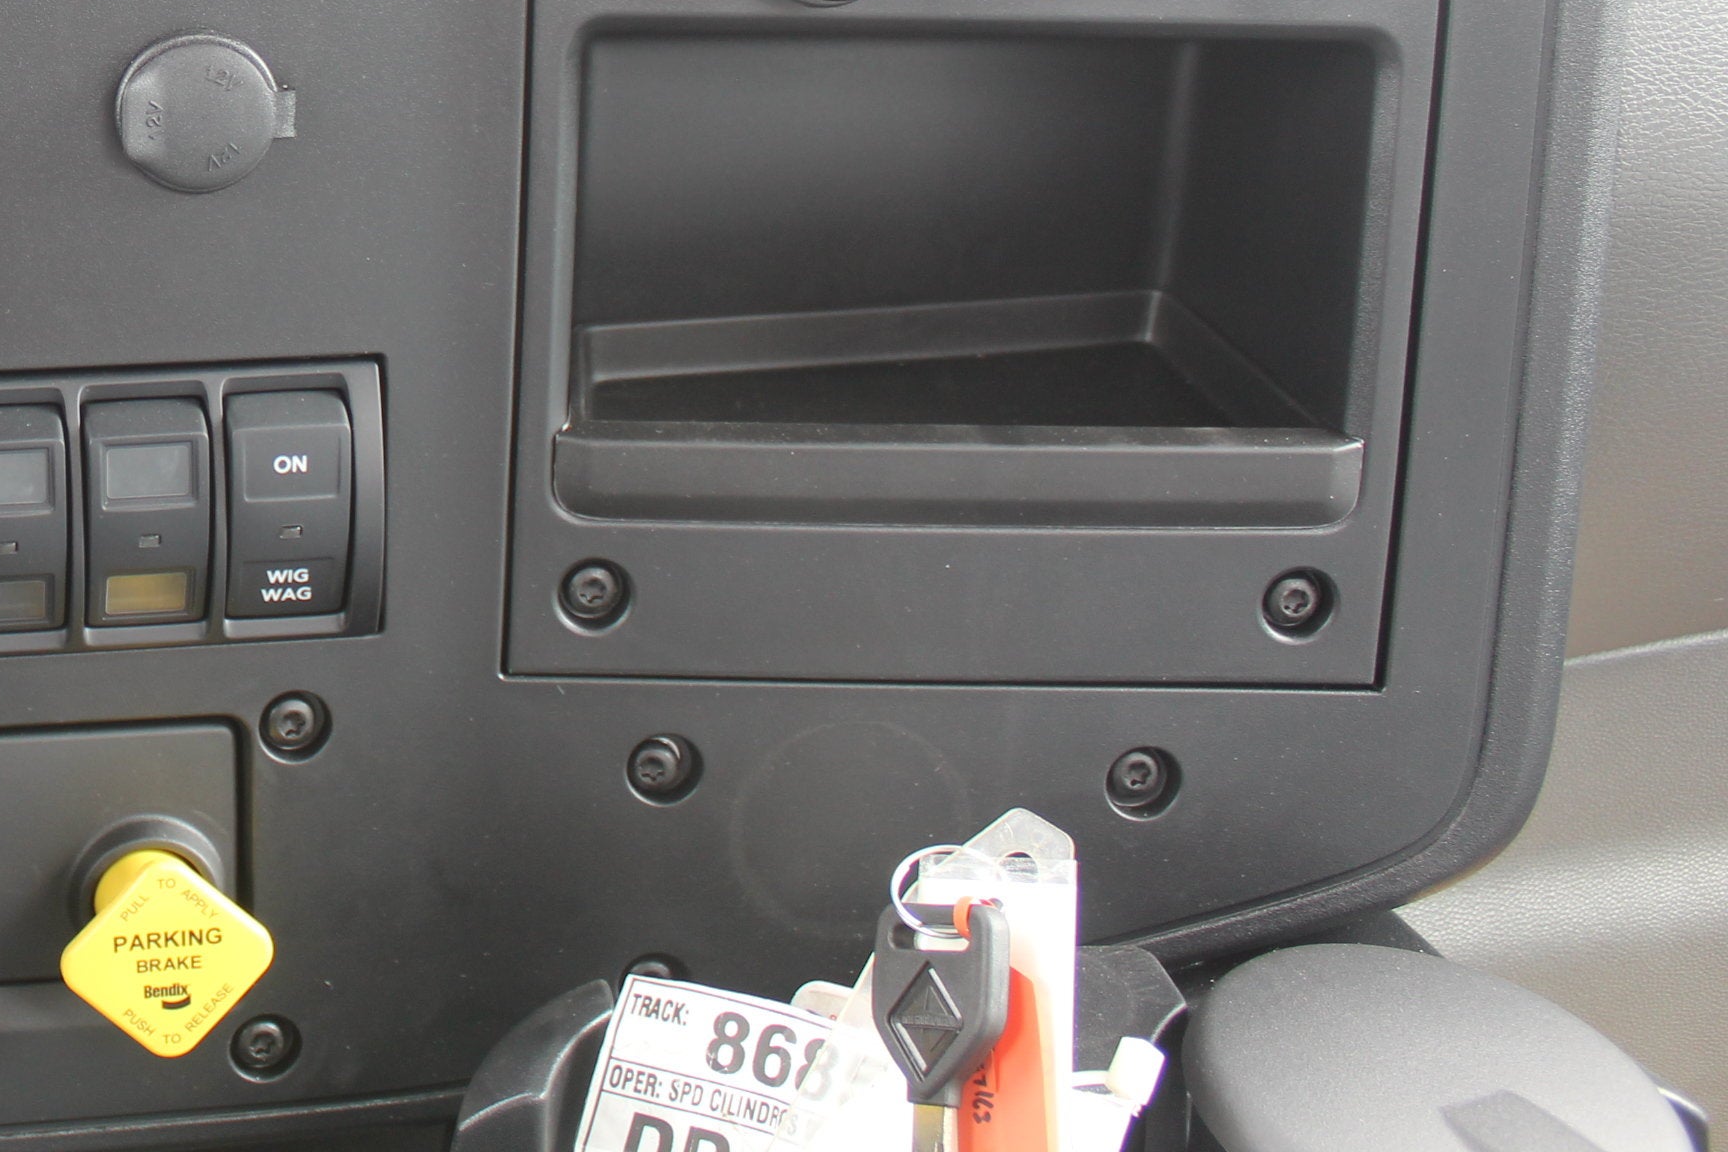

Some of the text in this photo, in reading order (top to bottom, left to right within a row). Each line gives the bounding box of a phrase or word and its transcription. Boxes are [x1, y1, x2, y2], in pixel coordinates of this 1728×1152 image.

[274, 456, 307, 473] ON
[267, 569, 308, 583] WIG
[262, 587, 311, 601] WAG
[120, 878, 218, 922] PULL TO APPLY
[114, 928, 221, 951] PARKING
[137, 956, 200, 973] BRAKE
[144, 983, 189, 999] Bendix
[123, 982, 234, 1044] PUSH TO RELEASE
[632, 993, 689, 1026] TRACK:
[609, 1065, 661, 1098] OPER:
[668, 1079, 704, 1107] SPD
